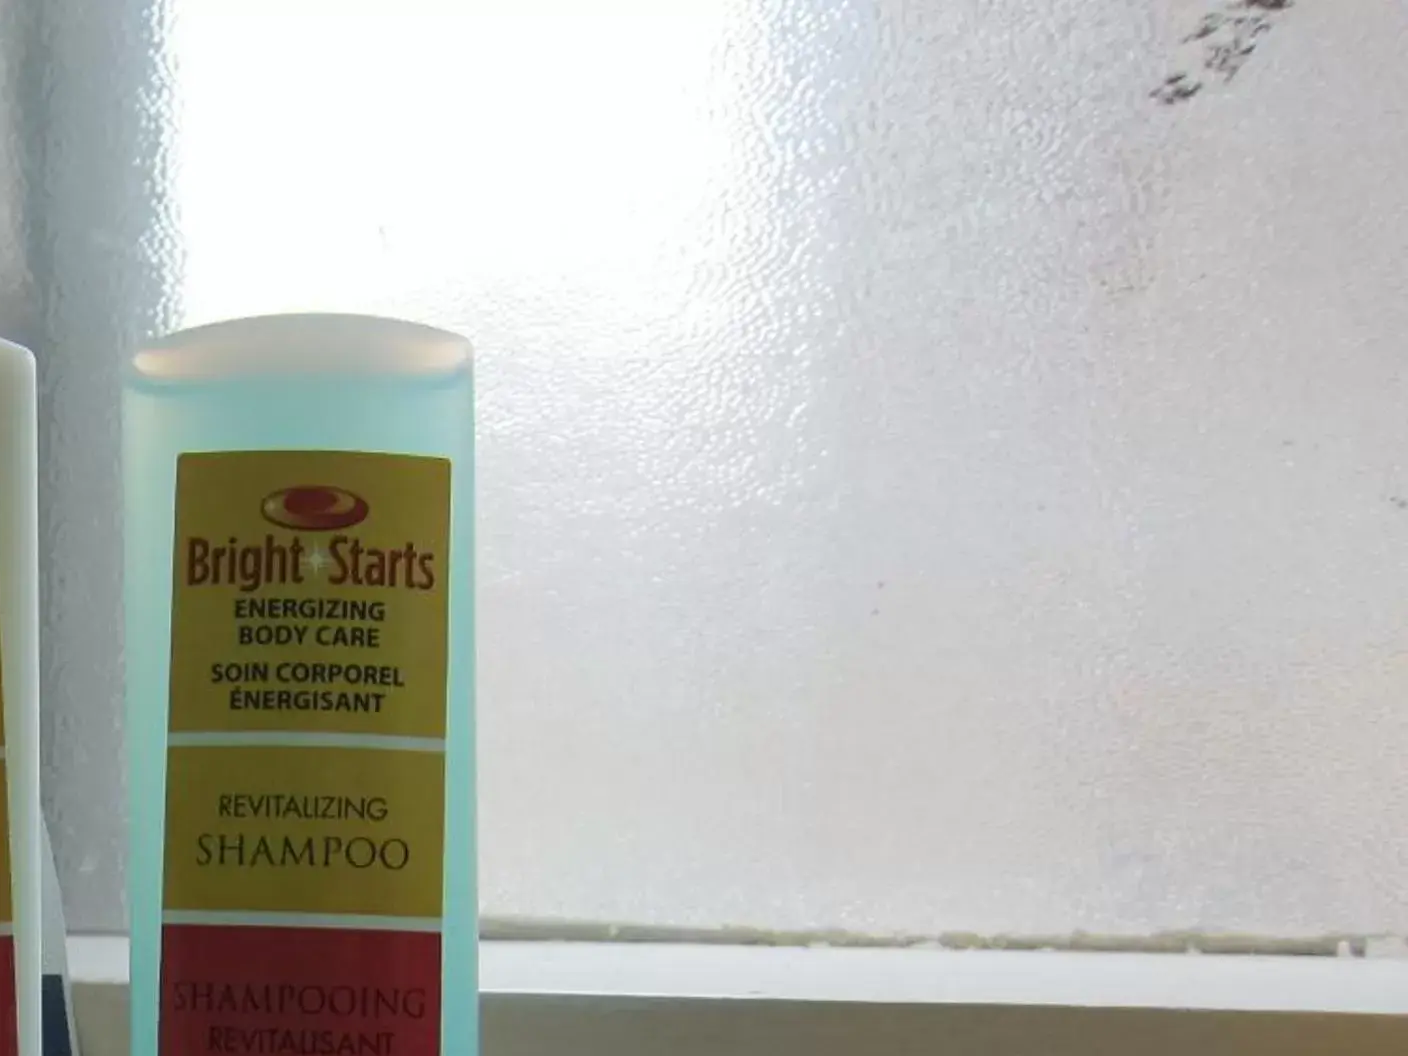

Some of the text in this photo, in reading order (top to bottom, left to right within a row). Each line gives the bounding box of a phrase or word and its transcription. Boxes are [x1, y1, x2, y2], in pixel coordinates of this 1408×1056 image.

[187, 534, 435, 592] Bright Starts
[234, 598, 386, 621] ENERGIZING
[238, 625, 380, 648] BODY CARE
[211, 663, 405, 687] SOIN CORPOREL
[229, 687, 386, 713] ÉNERGISANT
[218, 794, 389, 821] REVITALIZING
[195, 834, 410, 870] SHAMPOO
[173, 980, 426, 1020] SHAMPOOING
[208, 1026, 395, 1056] REVITALISANT
